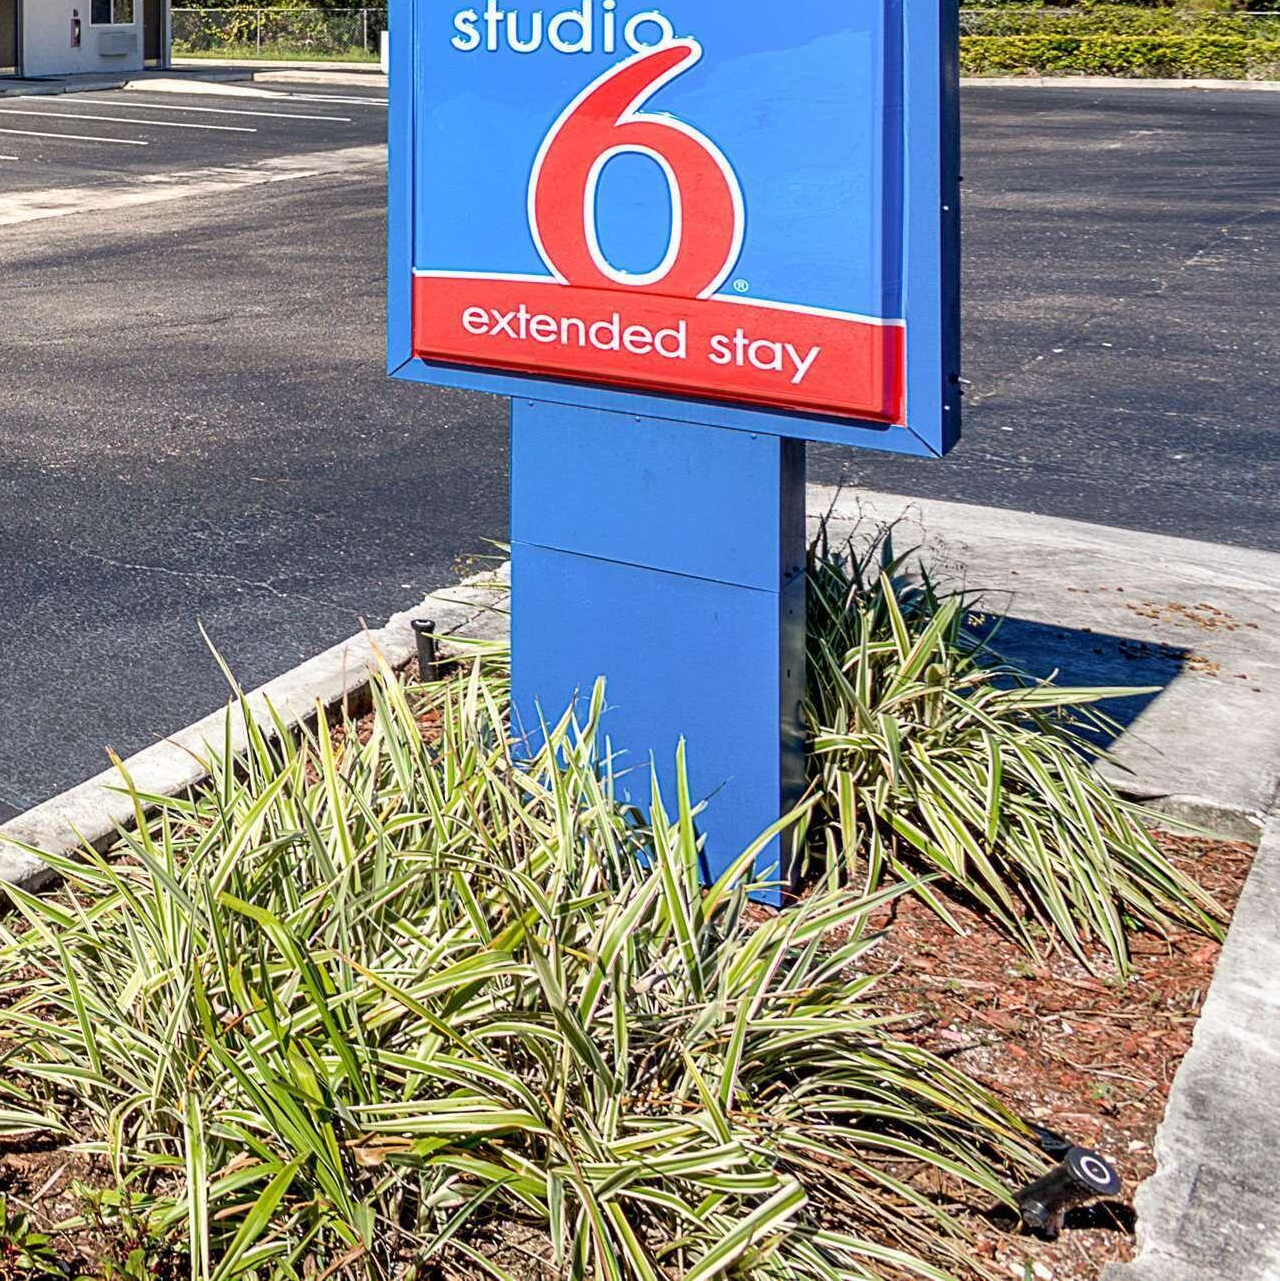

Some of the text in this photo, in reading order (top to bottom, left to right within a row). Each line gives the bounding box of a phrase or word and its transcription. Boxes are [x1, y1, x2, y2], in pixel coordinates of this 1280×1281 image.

[527, 36, 746, 299] 6
[461, 303, 821, 384] extended stay
